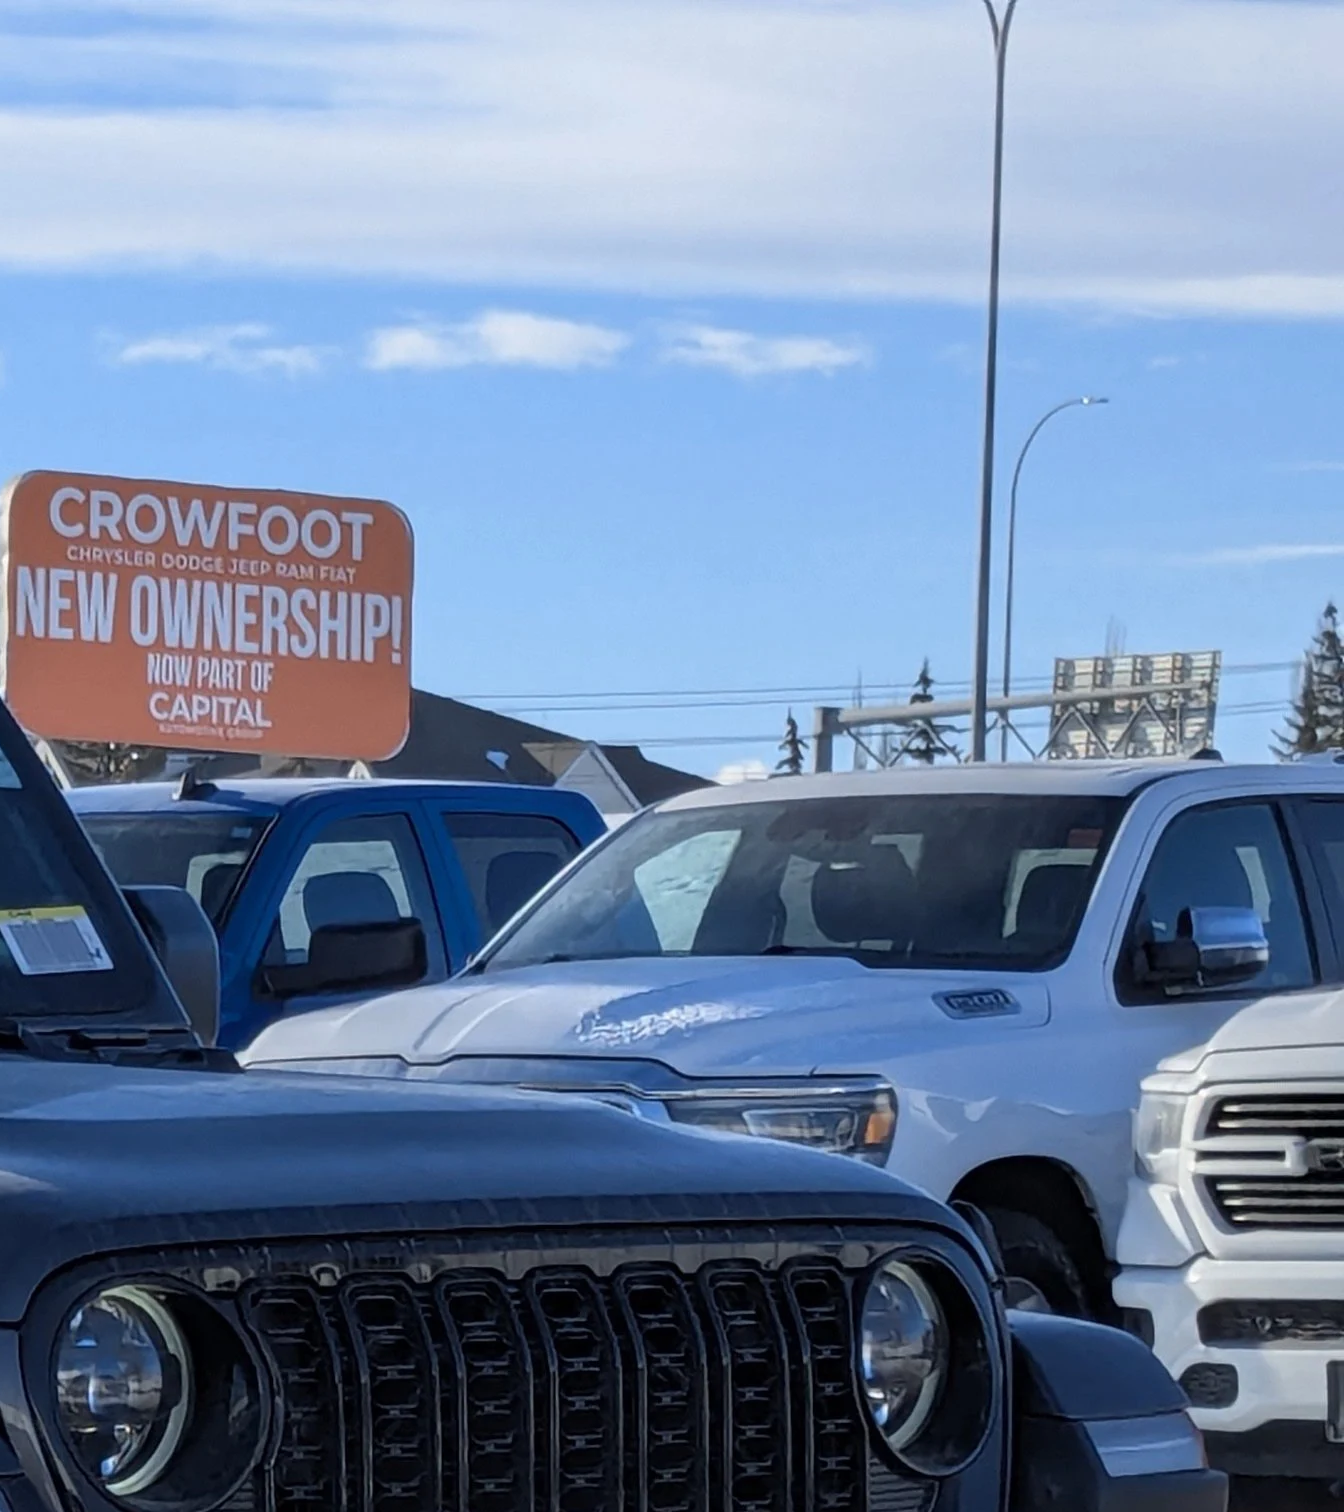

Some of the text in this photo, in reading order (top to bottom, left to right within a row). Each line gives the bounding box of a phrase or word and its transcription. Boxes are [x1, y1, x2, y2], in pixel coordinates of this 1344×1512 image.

[49, 487, 374, 561] CROWFOOT
[66, 545, 156, 567] CHRYSLER
[162, 552, 225, 574] DODGE
[227, 557, 272, 578] JEEP
[275, 562, 314, 580] RAM
[15, 566, 404, 664] NEW OWNERSHIP!
[146, 652, 275, 693] NOW PART OF
[148, 691, 273, 728] CAPITAL
